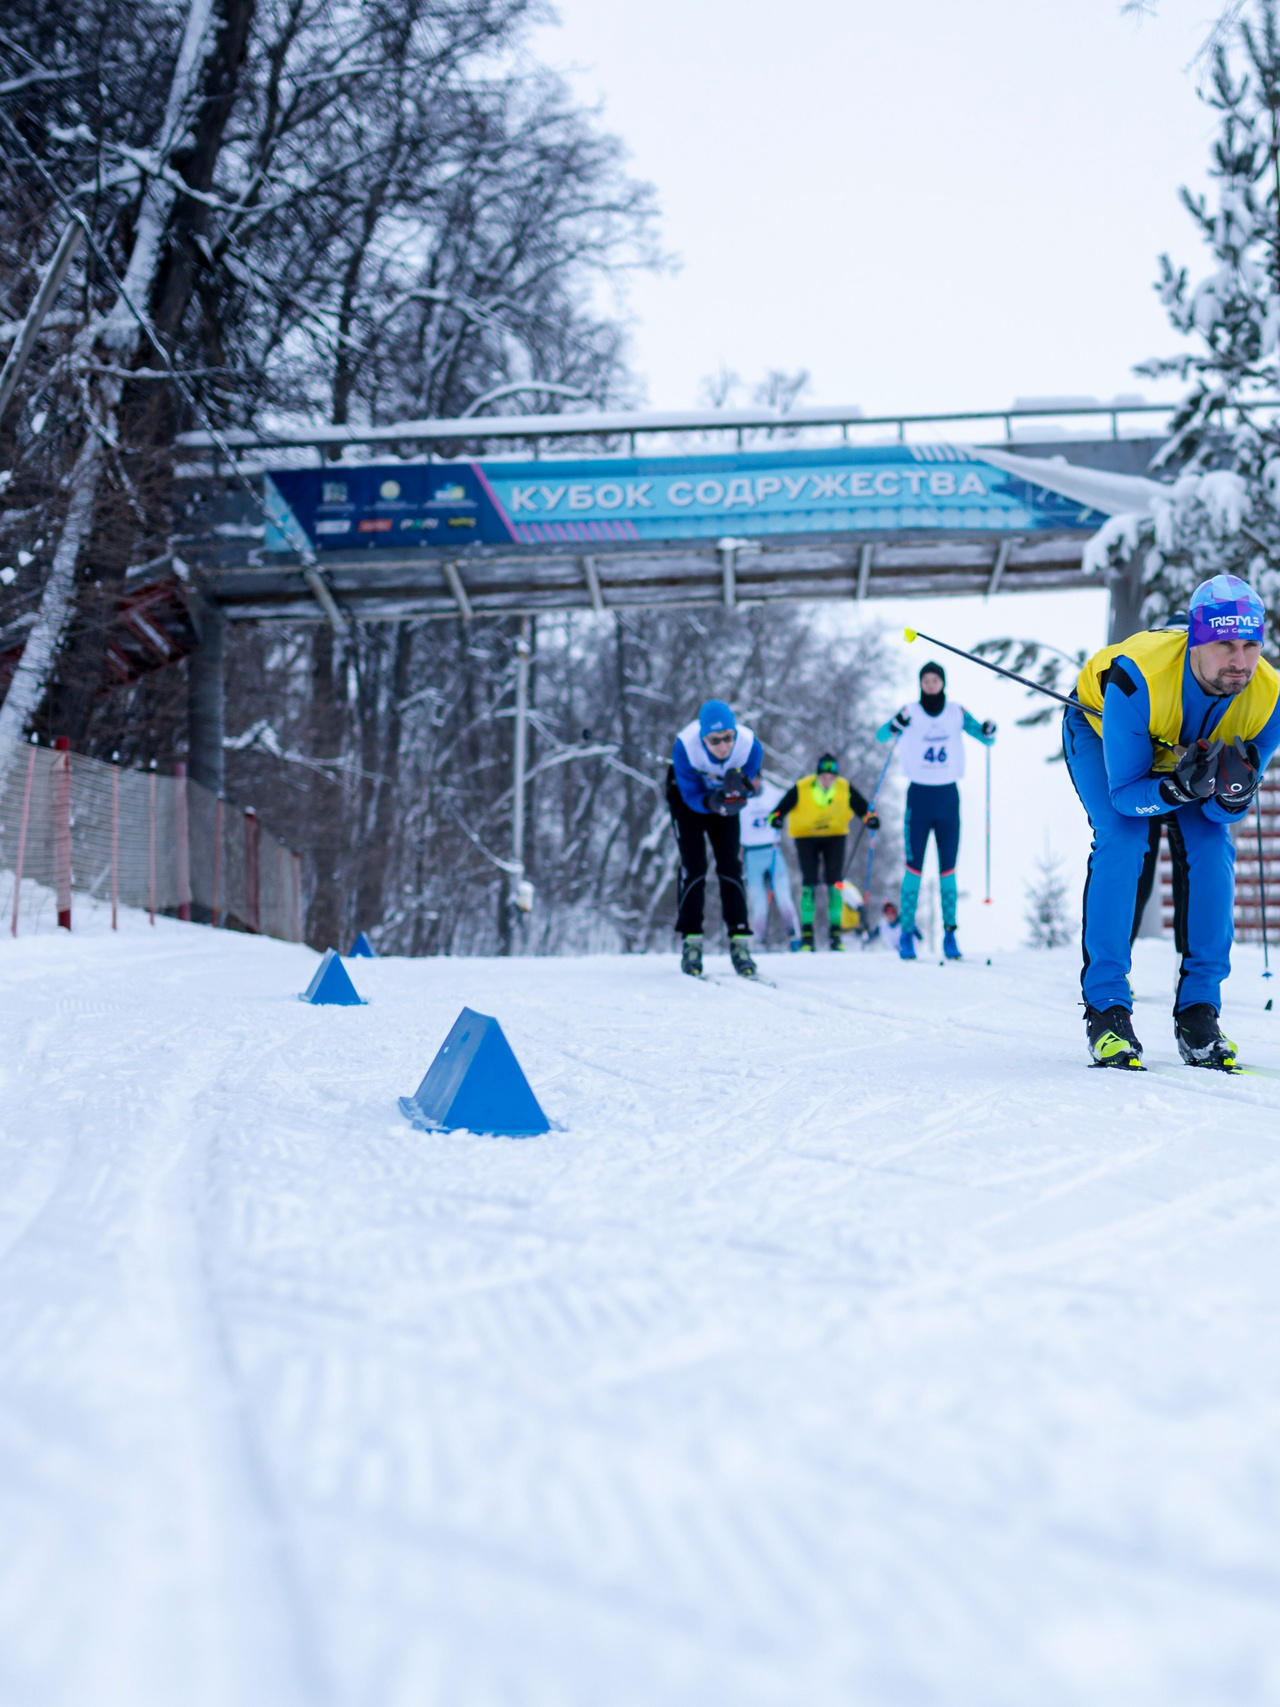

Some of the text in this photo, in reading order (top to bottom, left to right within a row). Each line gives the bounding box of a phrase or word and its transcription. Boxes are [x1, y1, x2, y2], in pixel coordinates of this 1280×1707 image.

[511, 470, 988, 512] КУБОК СОДРУЖЕСТВА
[1208, 615, 1260, 629] TRISTYLE
[924, 745, 947, 763] 46
